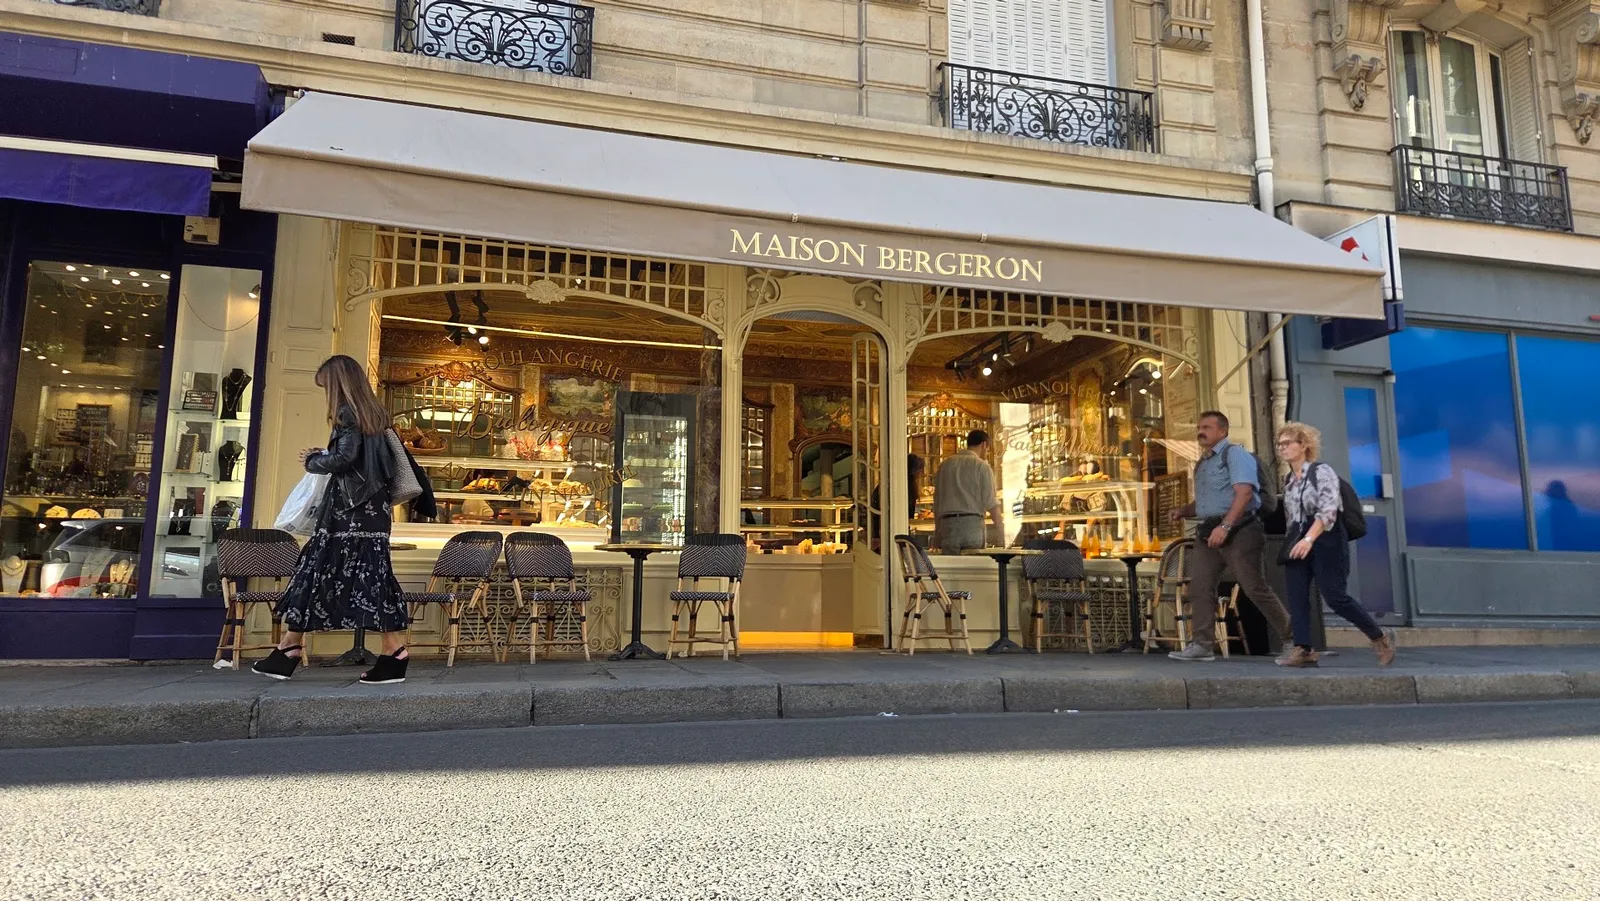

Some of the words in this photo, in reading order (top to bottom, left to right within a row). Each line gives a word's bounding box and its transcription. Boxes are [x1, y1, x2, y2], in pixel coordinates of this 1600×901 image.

[730, 229, 867, 268] MAISON
[876, 246, 1043, 282] BERGERON
[470, 348, 625, 383] BOULANGERIE
[1000, 380, 1115, 408] VIENNOISERIES
[456, 397, 612, 446] Biologique
